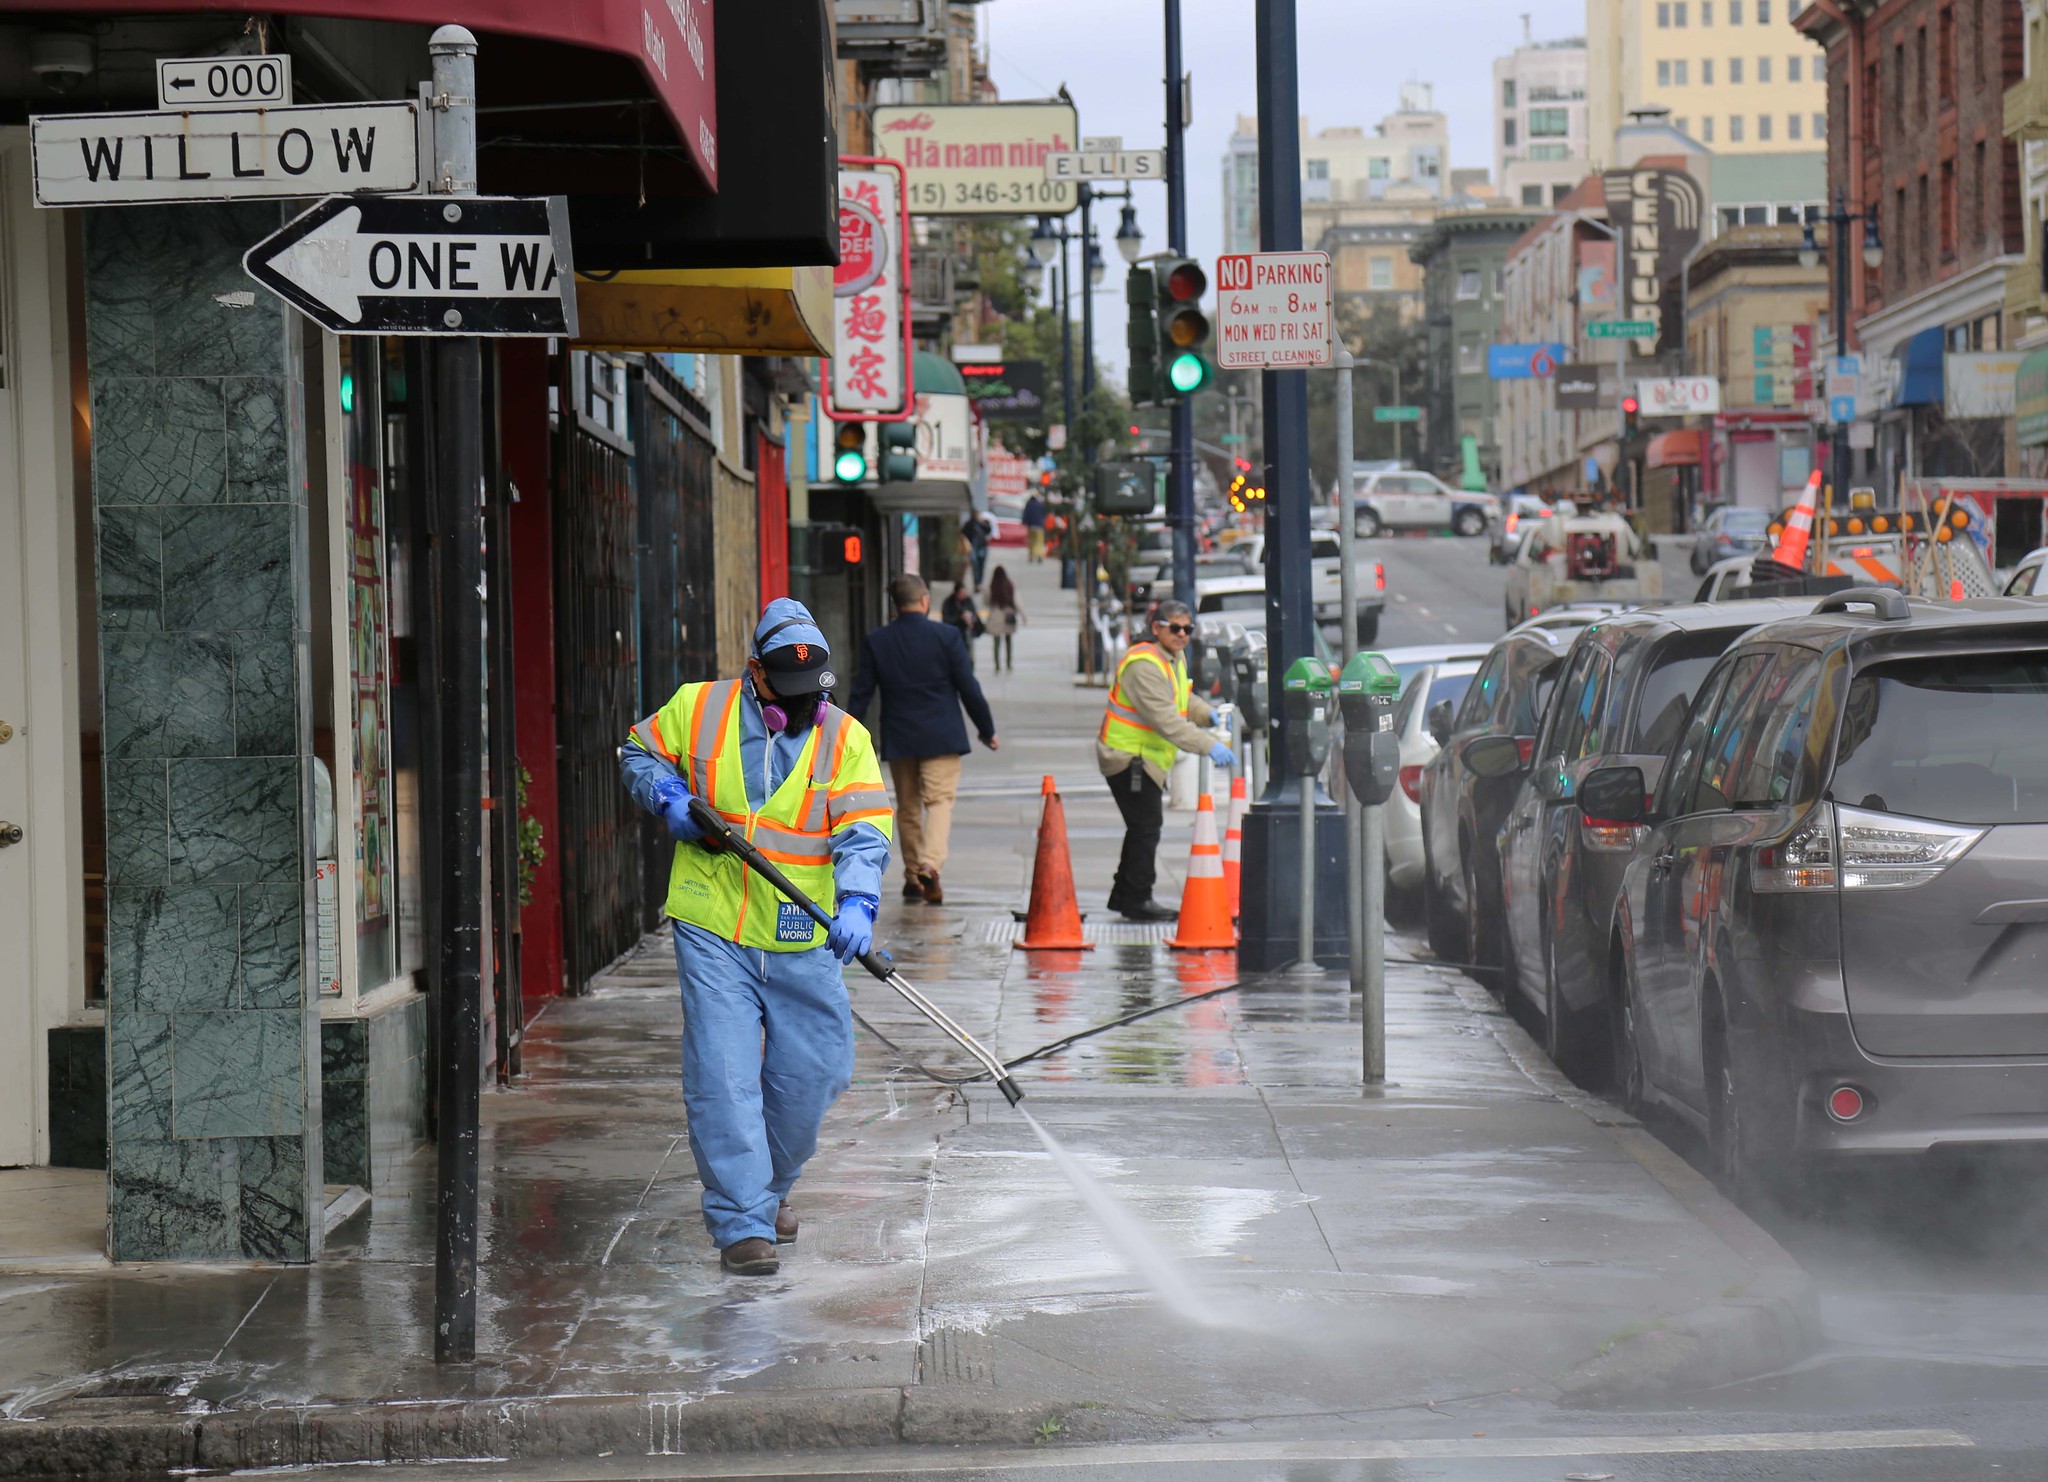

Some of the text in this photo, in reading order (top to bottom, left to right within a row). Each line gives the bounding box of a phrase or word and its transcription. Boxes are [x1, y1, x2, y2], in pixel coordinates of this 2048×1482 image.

[207, 63, 277, 98] 000
[80, 126, 376, 182] WILLOW
[1057, 156, 1150, 174] ELLIS
[956, 181, 1067, 205] 346-3100
[369, 240, 478, 290] ONE
[1221, 258, 1323, 288] NO PARKING
[1268, 305, 1278, 314] TO
[1225, 321, 1323, 342] MON WED FRI SAT
[1229, 349, 1322, 363] STREET CLEANING
[780, 920, 814, 930] PUBLIC
[780, 930, 812, 940] WORKS
